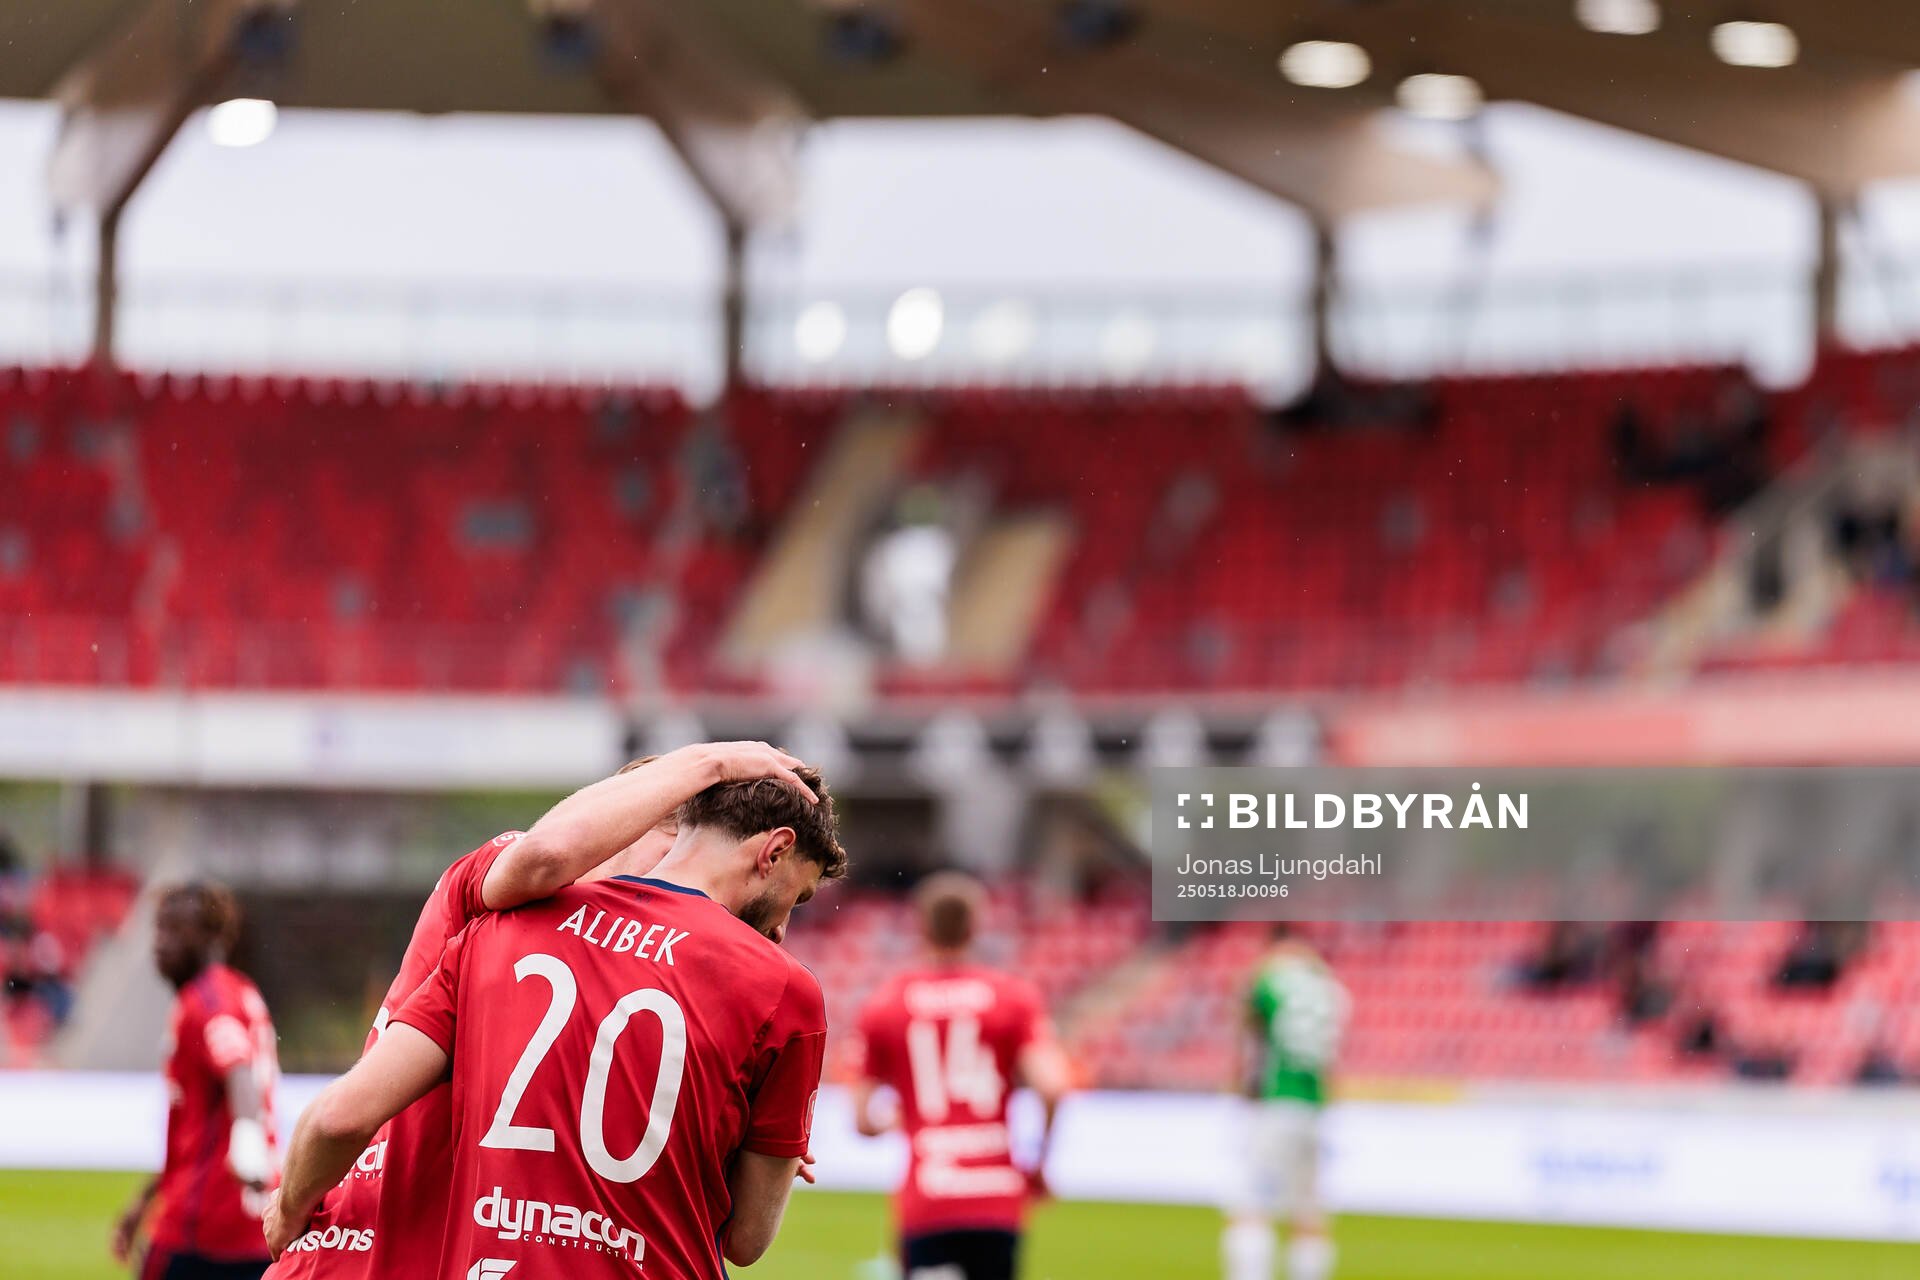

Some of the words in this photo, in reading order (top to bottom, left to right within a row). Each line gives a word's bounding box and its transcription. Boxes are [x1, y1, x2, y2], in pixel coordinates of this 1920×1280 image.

[556, 904, 691, 966] ALIBEK
[478, 953, 687, 1184] 20
[906, 1013, 1003, 1123] 14
[473, 1186, 646, 1262] dynacon
[523, 1233, 644, 1272] CONSTRUCTIN
